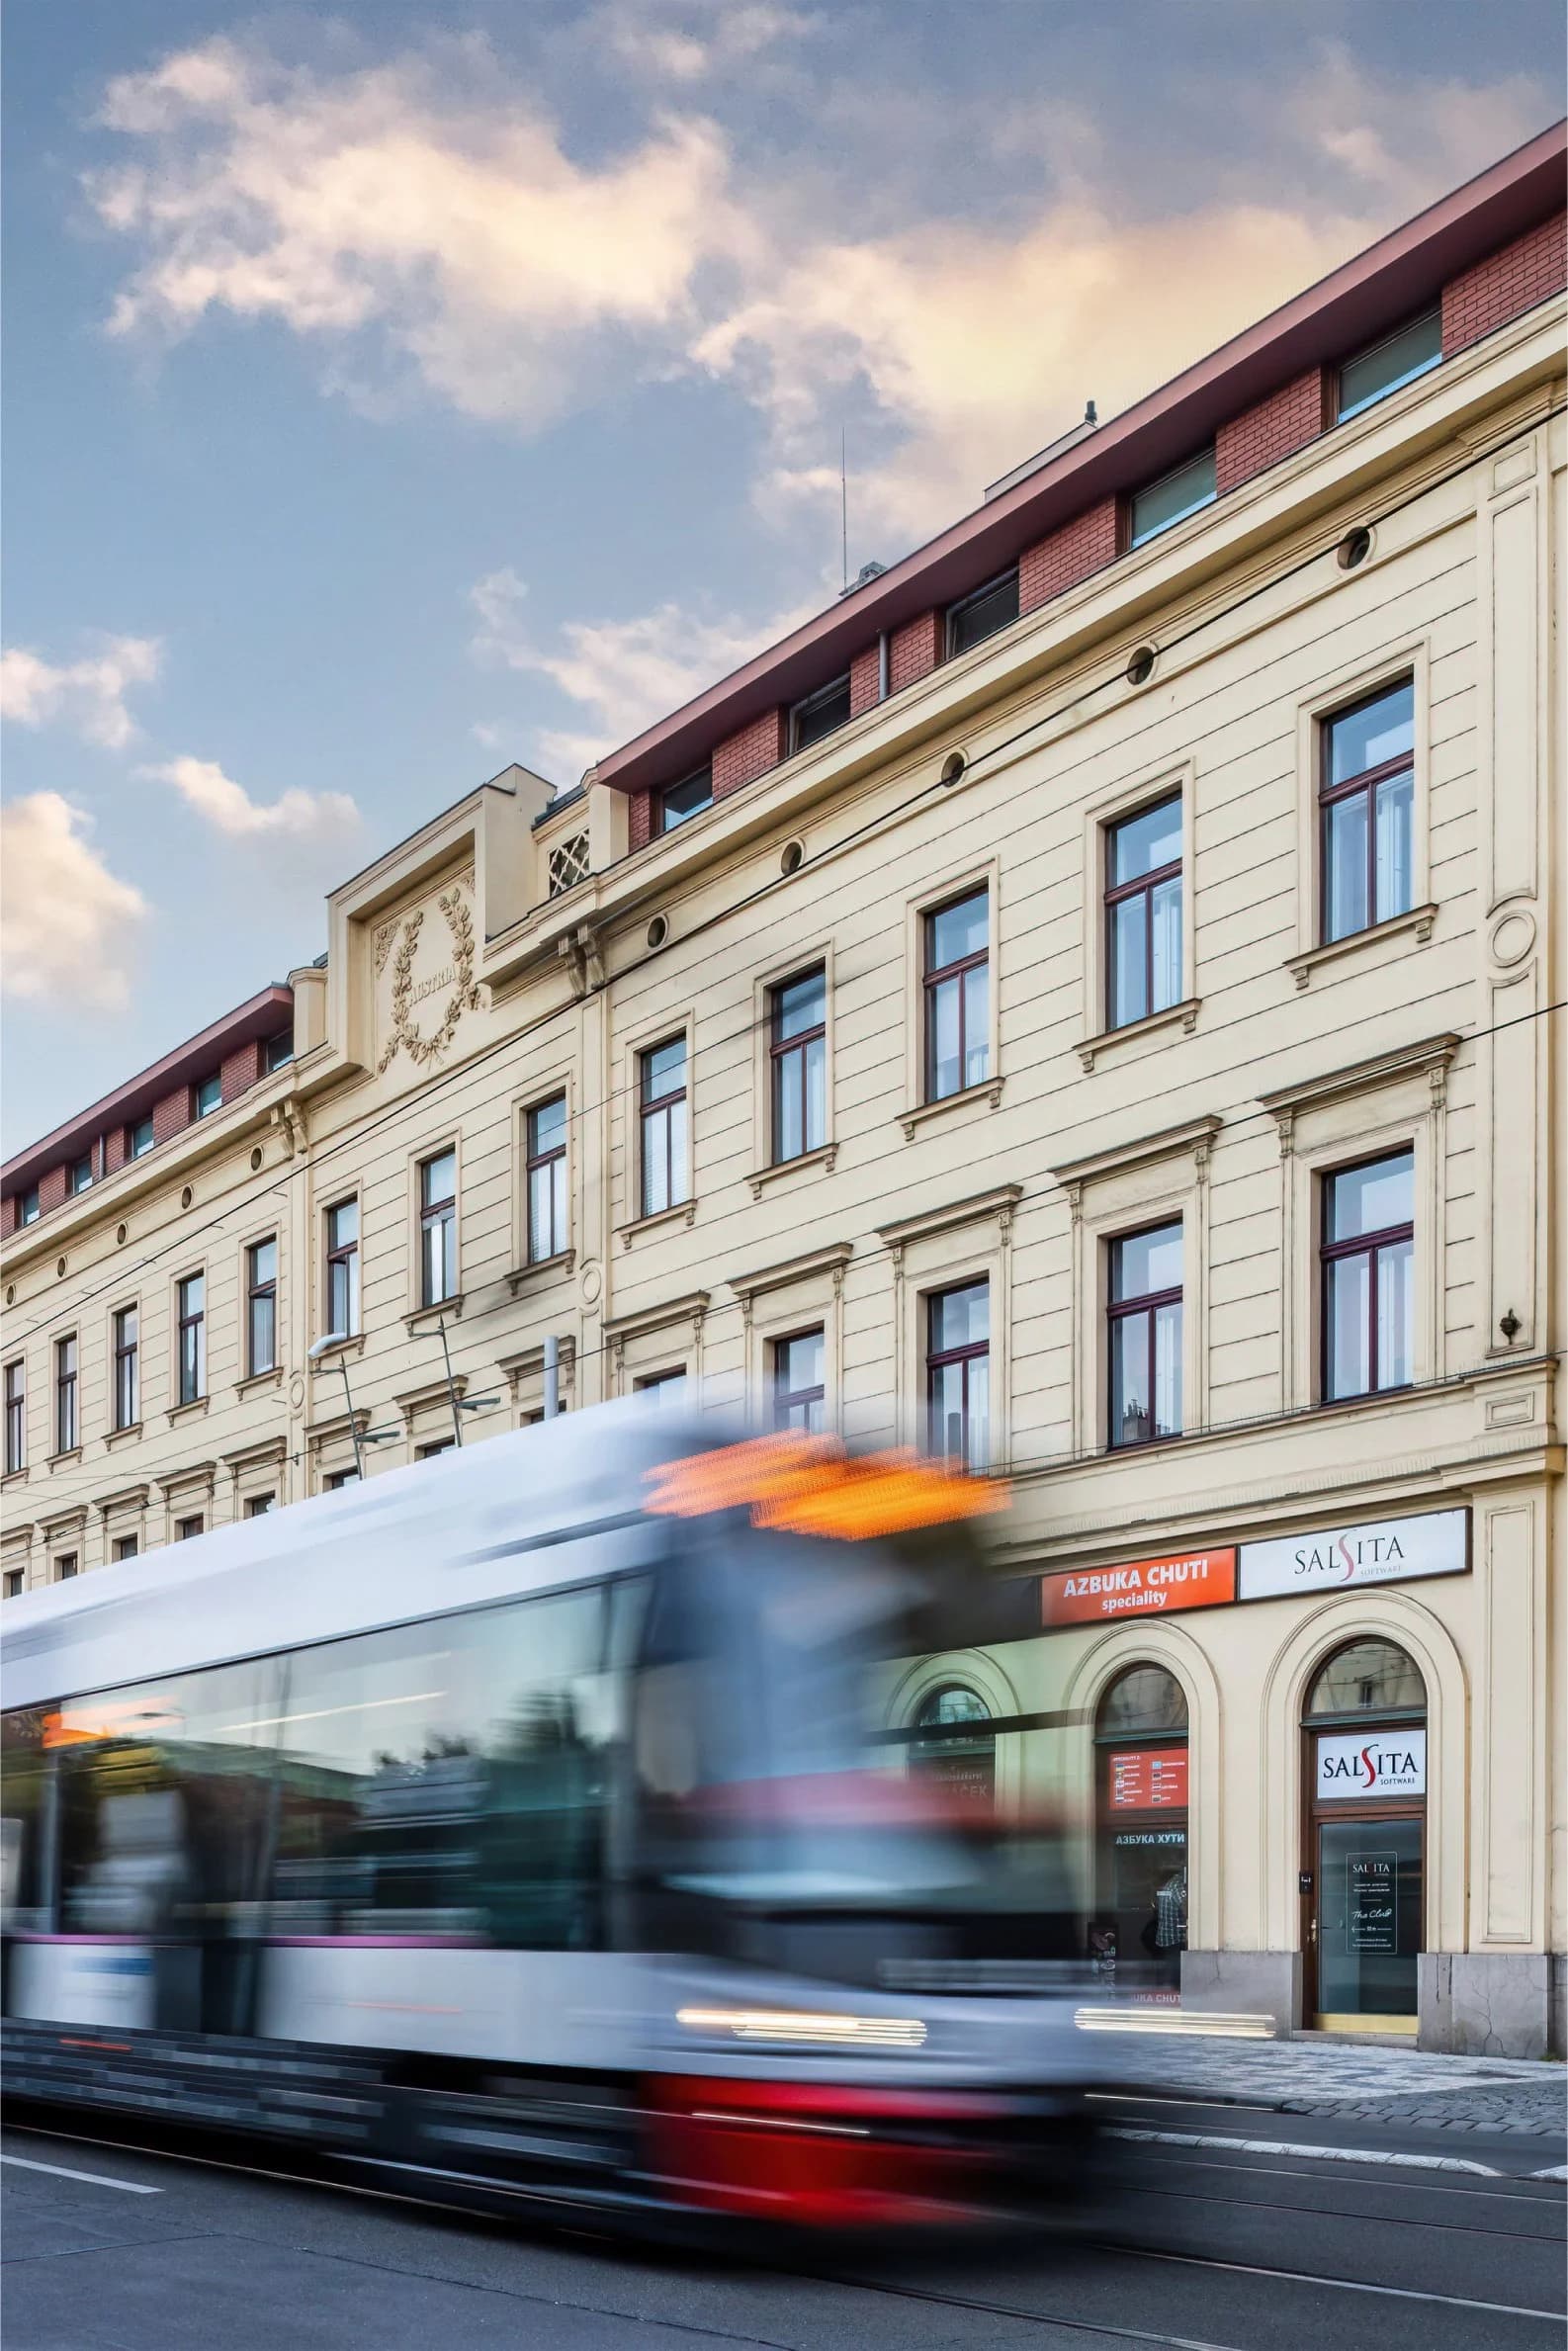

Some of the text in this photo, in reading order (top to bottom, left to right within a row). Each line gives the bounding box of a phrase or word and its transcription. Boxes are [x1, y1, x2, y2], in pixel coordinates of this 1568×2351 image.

[1294, 1531, 1405, 1582] SALSITA
[1063, 1559, 1208, 1598] AZBUKA CHUTI
[1101, 1590, 1168, 1612] speciality
[1323, 1744, 1419, 1787] SALSITA
[1380, 1777, 1416, 1785] SOFTWARE
[1115, 1833, 1185, 1845] АЗБУКА ХУТИ
[1352, 1863, 1390, 1873] SALITA
[1156, 1993, 1181, 2003] CHUT
